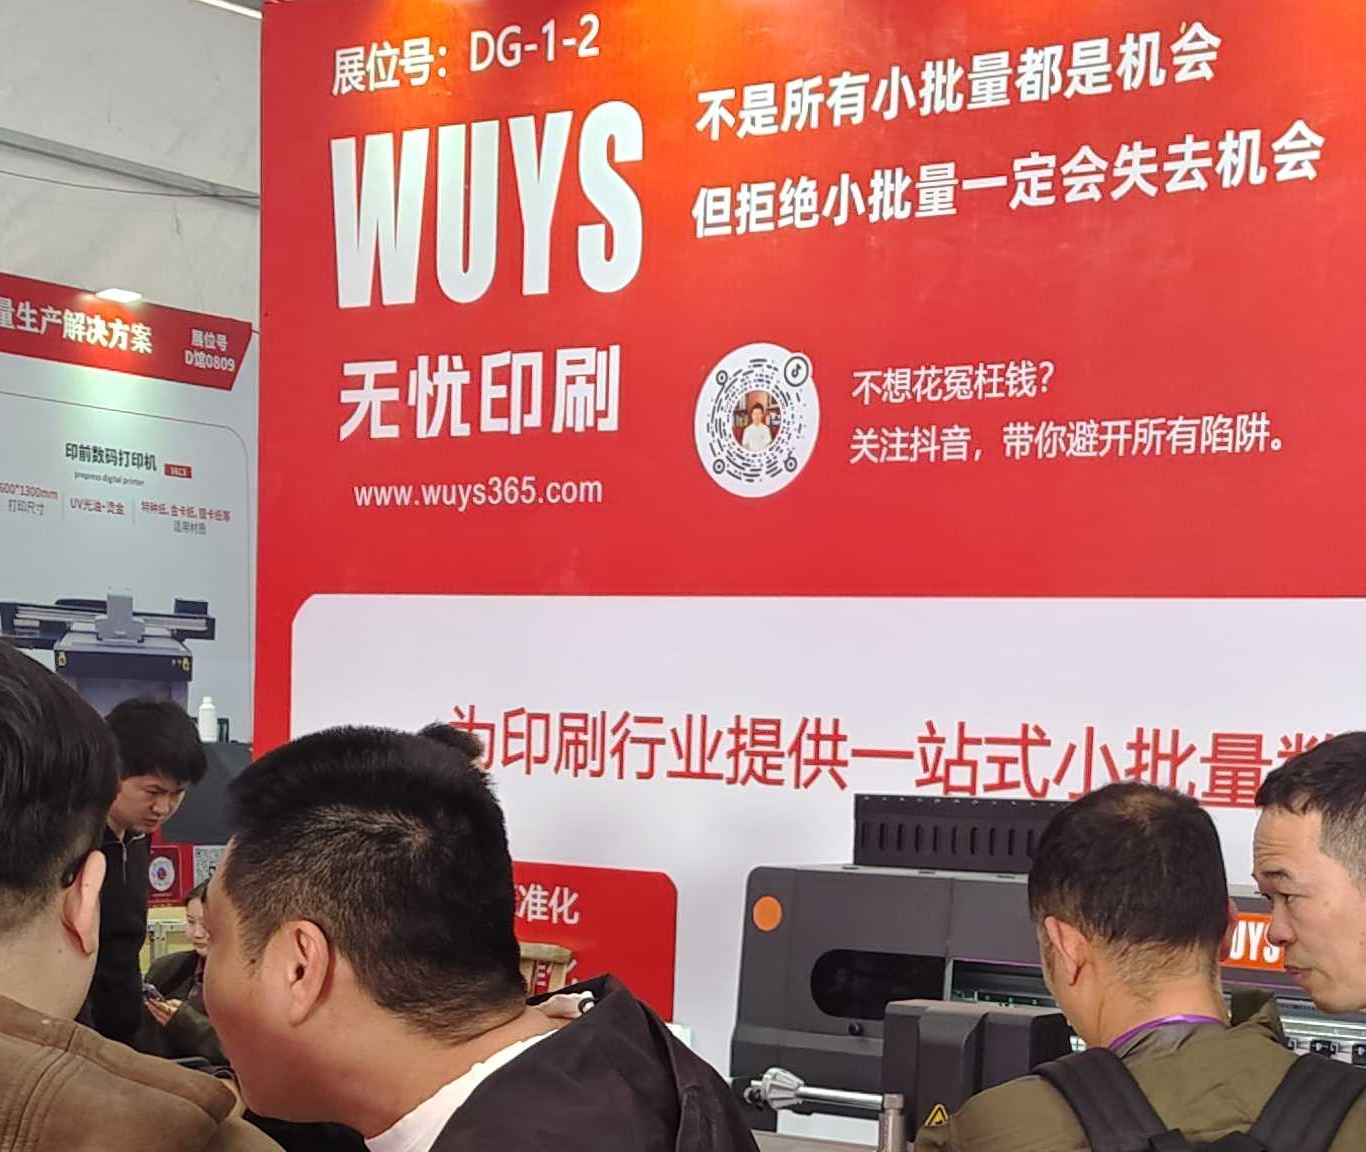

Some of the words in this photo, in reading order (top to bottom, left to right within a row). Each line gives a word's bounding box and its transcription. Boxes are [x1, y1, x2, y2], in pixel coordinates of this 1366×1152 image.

[695, 20, 1221, 141] 不是所有小批量都是机会
[691, 118, 1326, 239] 但拒绝小批量一定会失去机会
[331, 100, 644, 308] WUYS
[185, 350, 235, 372] D馆0809
[191, 328, 228, 351] 展位号
[340, 344, 620, 441] 无忧印刷
[65, 442, 157, 471] 印前数码打印机
[849, 411, 1283, 465] 关注抖音，带你避开所有陷阱。
[354, 476, 603, 512] www.wuys365.com
[514, 883, 579, 925] 准化
